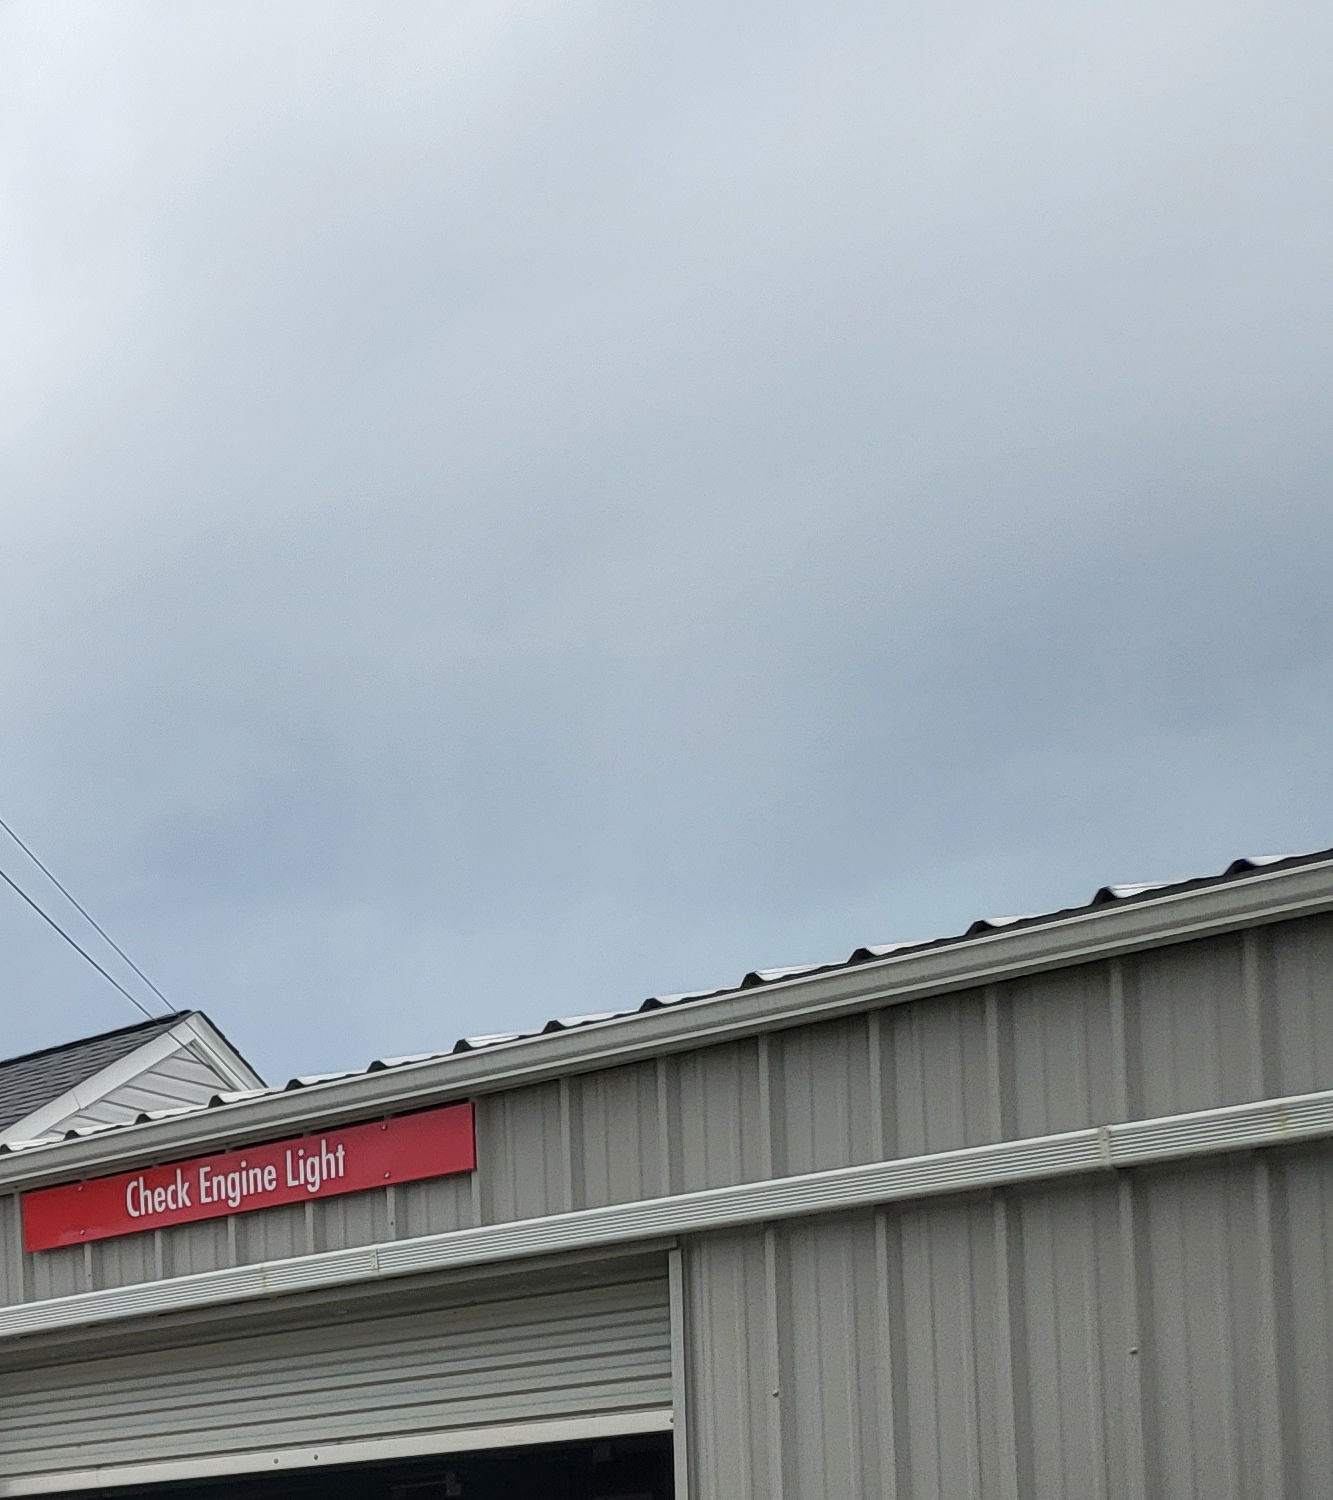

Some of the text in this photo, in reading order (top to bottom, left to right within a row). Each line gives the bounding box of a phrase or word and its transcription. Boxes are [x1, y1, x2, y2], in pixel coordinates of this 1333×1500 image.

[125, 1139, 346, 1218] Check Engine Light
